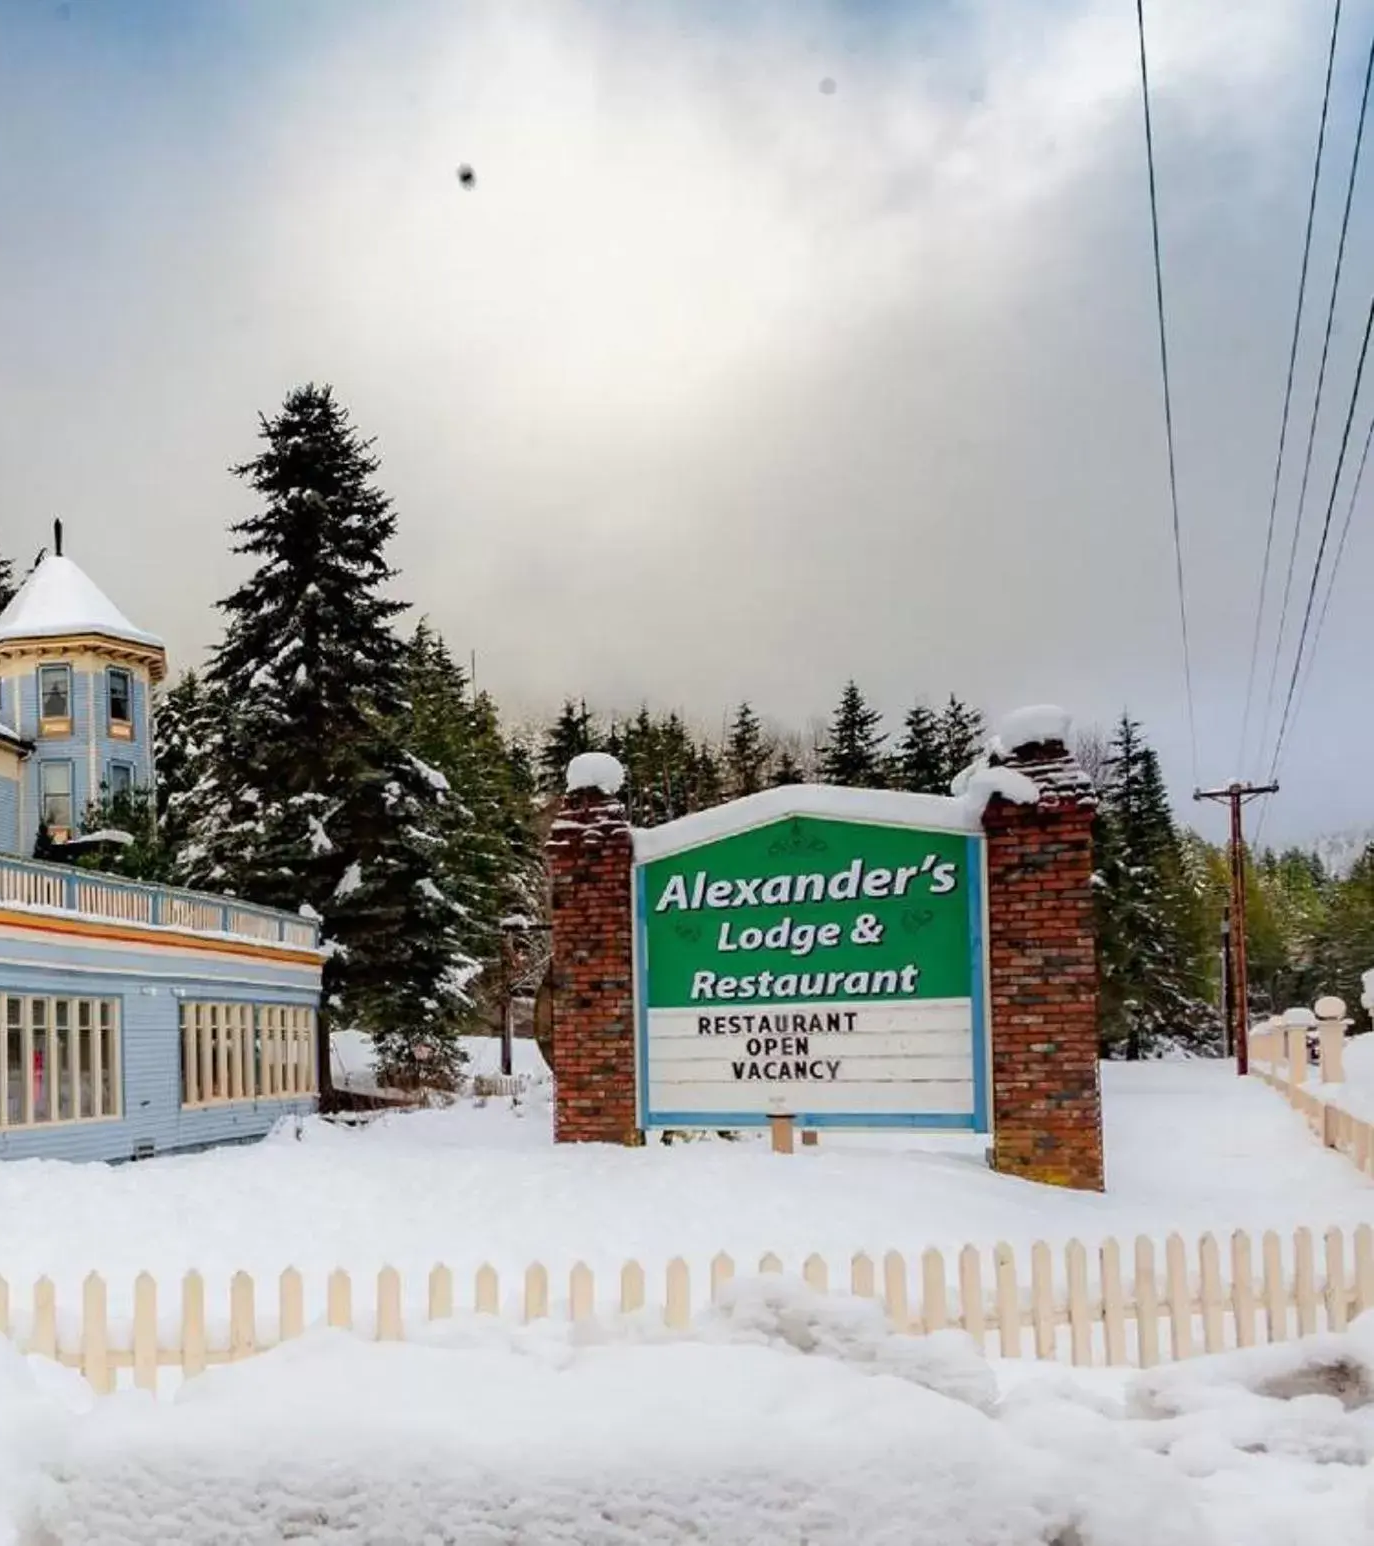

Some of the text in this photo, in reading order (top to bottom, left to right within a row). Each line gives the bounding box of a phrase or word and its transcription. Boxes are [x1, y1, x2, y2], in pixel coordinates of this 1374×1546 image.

[654, 854, 958, 913] Alexander's
[717, 913, 885, 957] Lodge &
[690, 963, 920, 1000] Restaurant
[697, 1012, 858, 1035] RESTAURANT
[745, 1037, 809, 1056] OPEN
[731, 1060, 842, 1081] VACANCY
